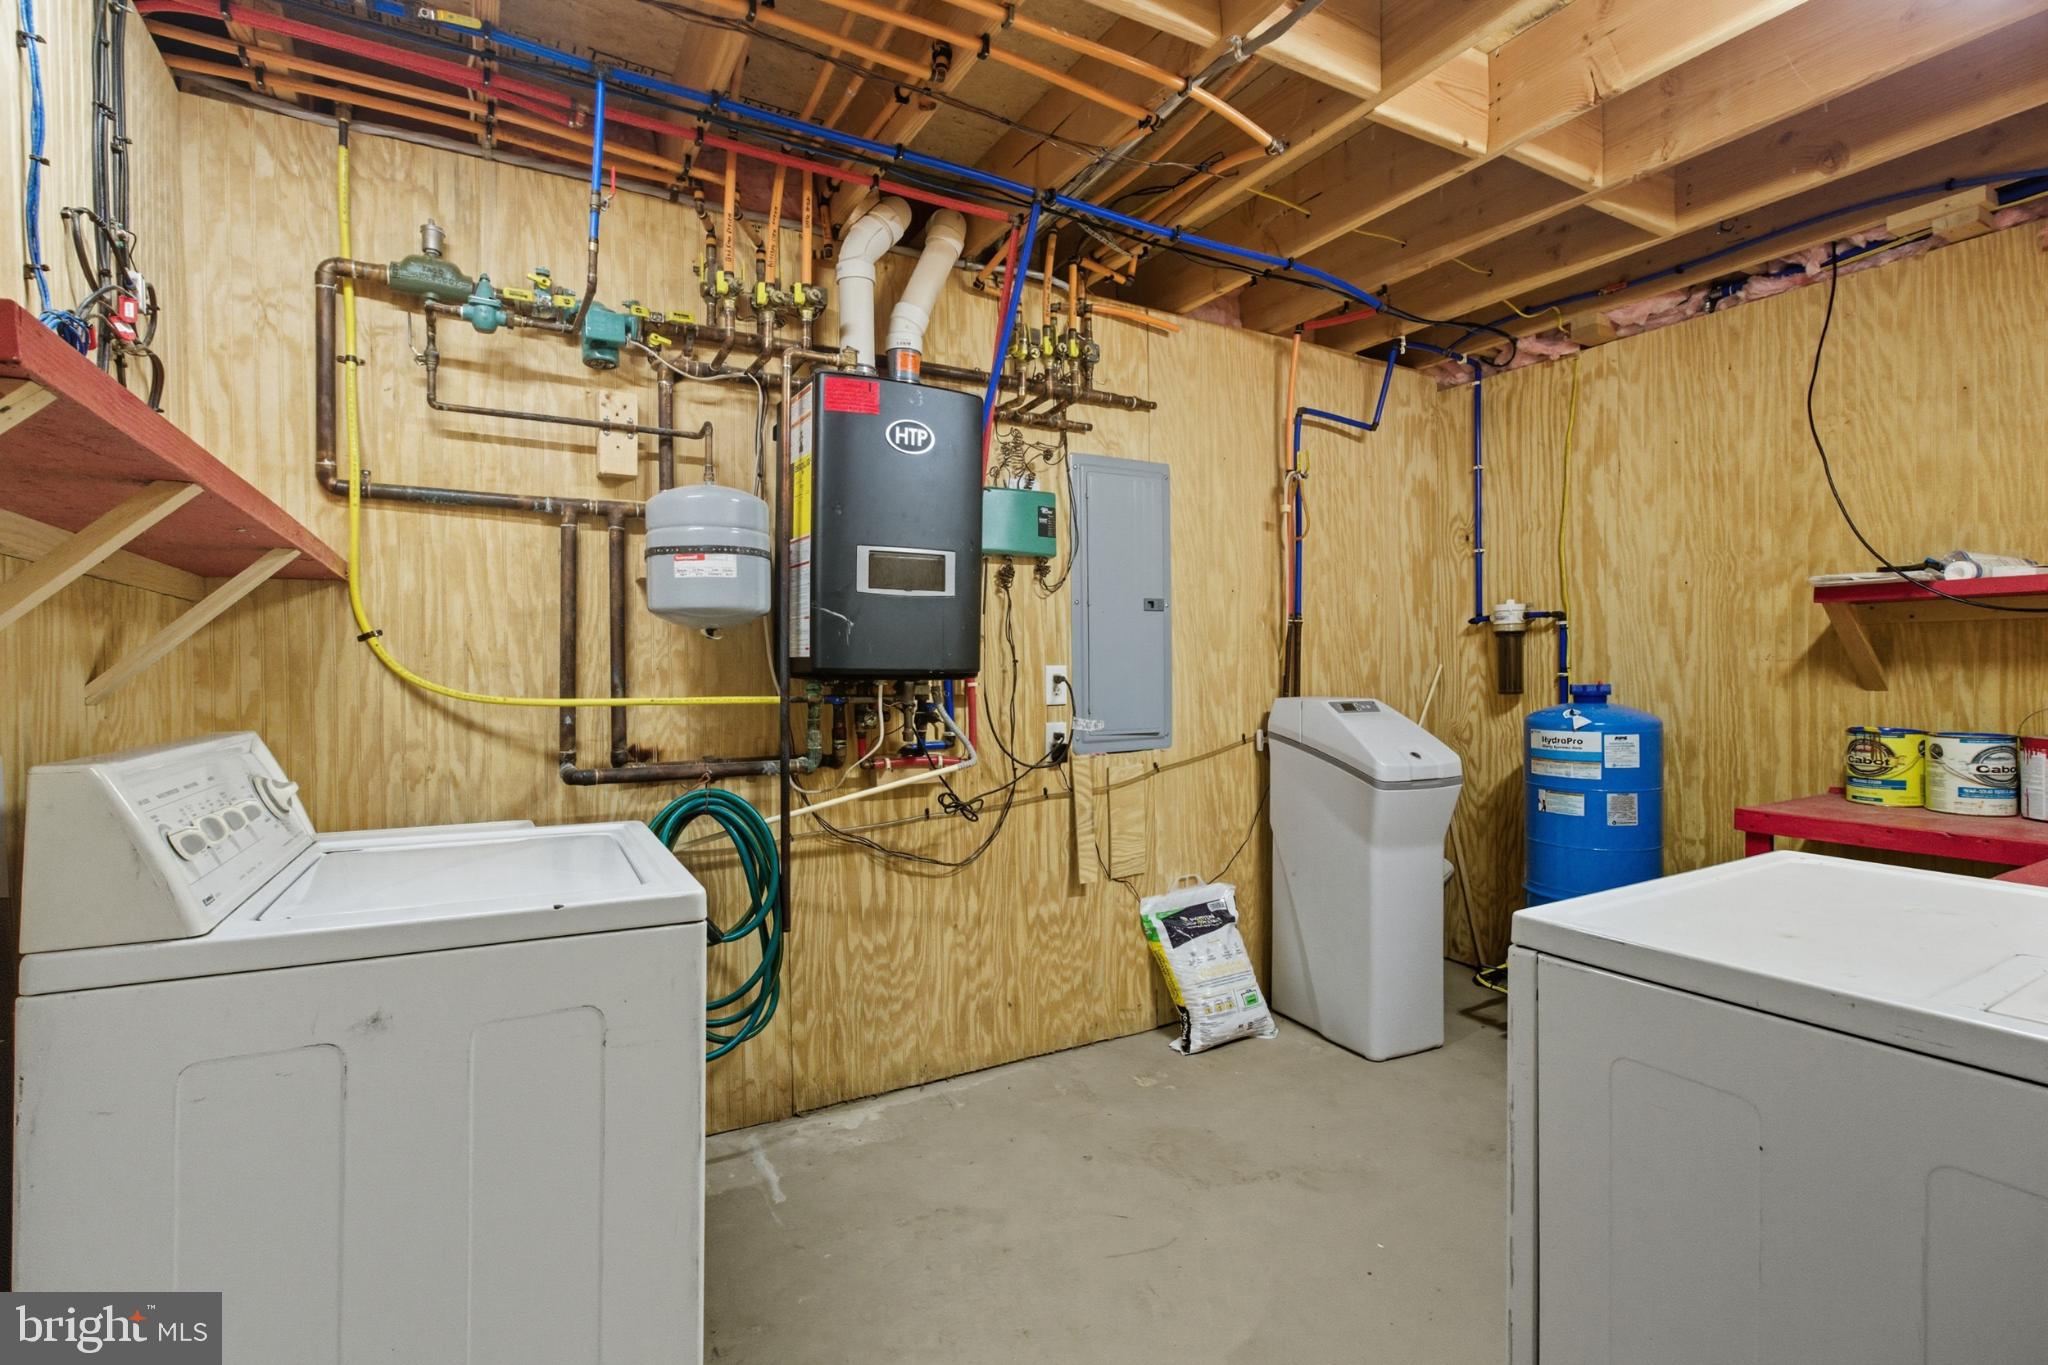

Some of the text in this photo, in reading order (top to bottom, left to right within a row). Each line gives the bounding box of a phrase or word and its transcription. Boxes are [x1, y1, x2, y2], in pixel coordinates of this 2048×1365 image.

[896, 426, 928, 446] HTP
[1541, 736, 1584, 746] HydroPro
[1847, 755, 1890, 766] Cabot
